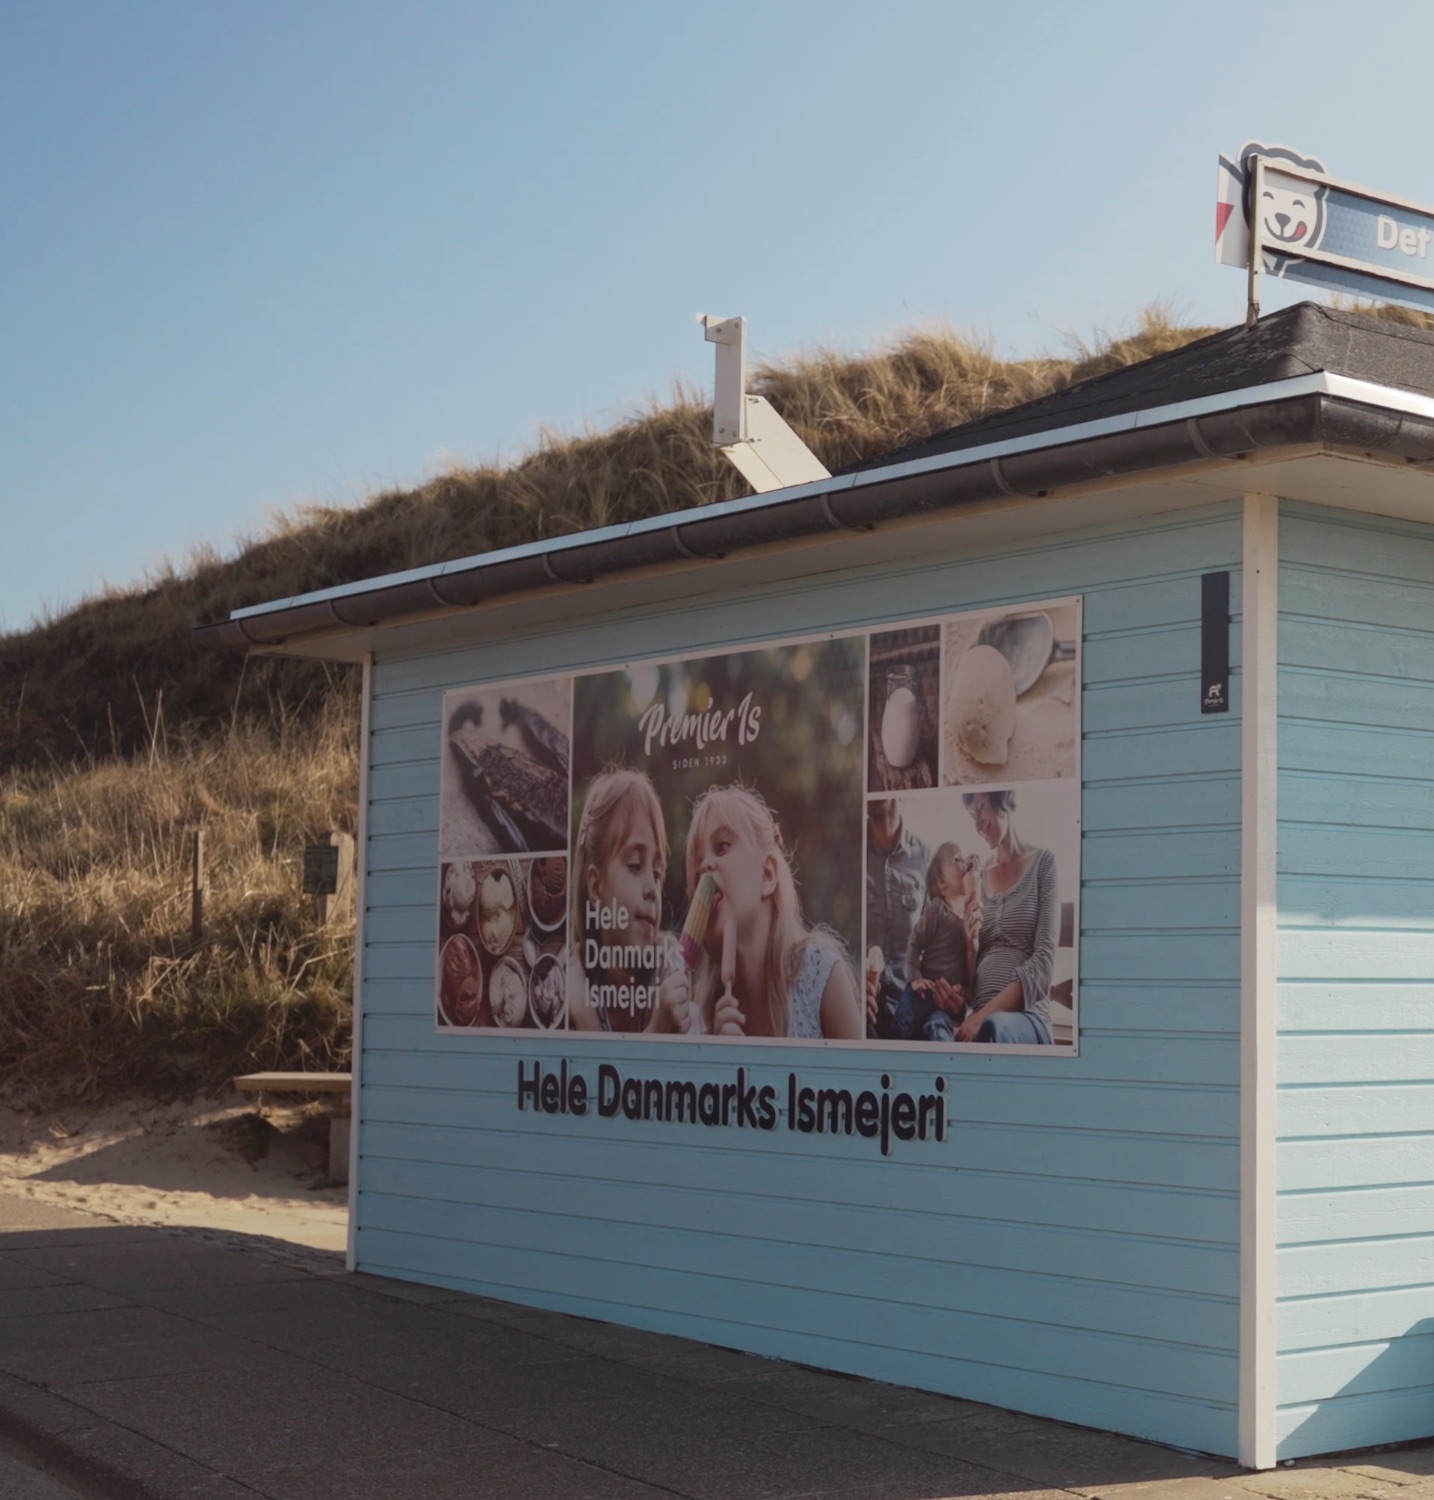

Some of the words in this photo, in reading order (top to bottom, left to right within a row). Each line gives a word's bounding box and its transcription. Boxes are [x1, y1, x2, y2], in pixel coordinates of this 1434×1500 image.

[1376, 214, 1430, 259] Det
[638, 697, 735, 756] Premier
[737, 691, 762, 746] Is
[672, 757, 700, 770] SIDEN
[705, 755, 728, 767] 1933
[585, 897, 630, 930] Hele
[585, 938, 685, 970] Danmarks
[585, 976, 660, 1018] Ismejeri
[517, 1057, 588, 1116] Hele
[597, 1064, 780, 1130] Danmarks
[788, 1072, 949, 1157] Ismejeri
